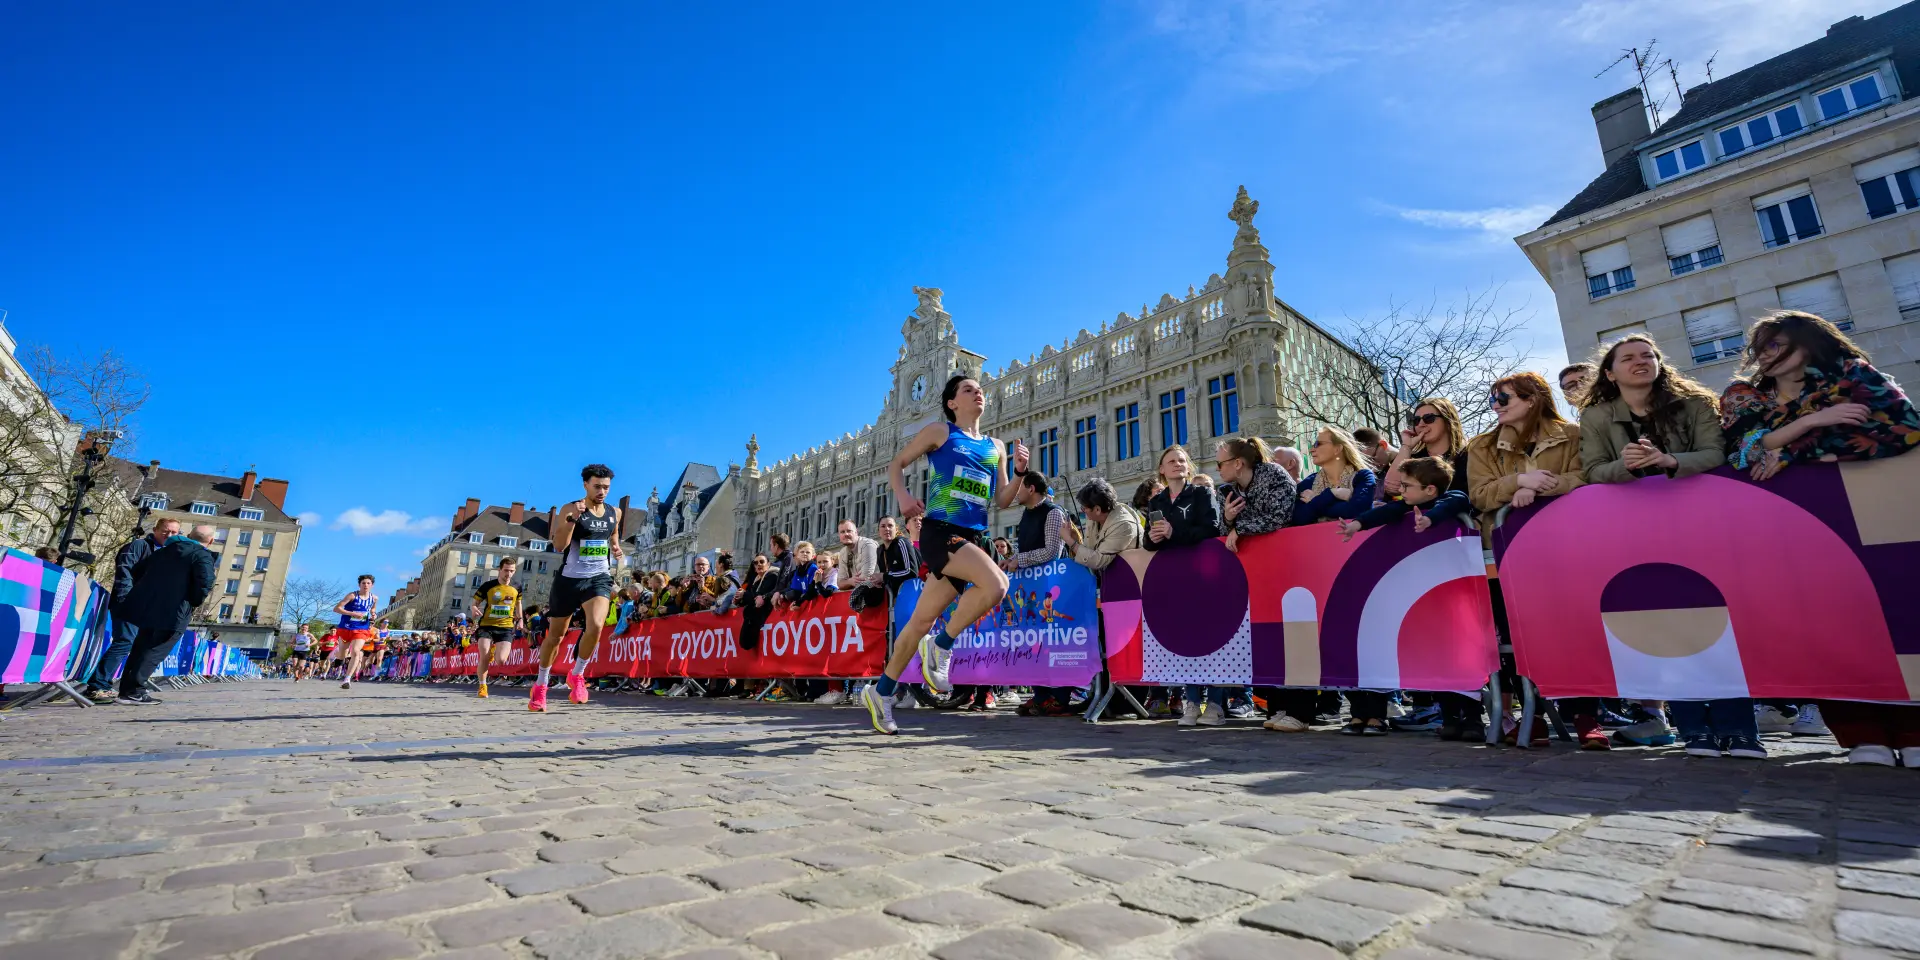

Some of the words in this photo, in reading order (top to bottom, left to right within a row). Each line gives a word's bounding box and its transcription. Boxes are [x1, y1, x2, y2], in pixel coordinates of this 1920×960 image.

[954, 478, 988, 497] 4368
[581, 547, 607, 555] 4296
[608, 635, 651, 662] TOYOTA
[670, 627, 738, 660] TOYOTA
[760, 615, 865, 657] TOYOTA
[1000, 622, 1088, 652] sportive
